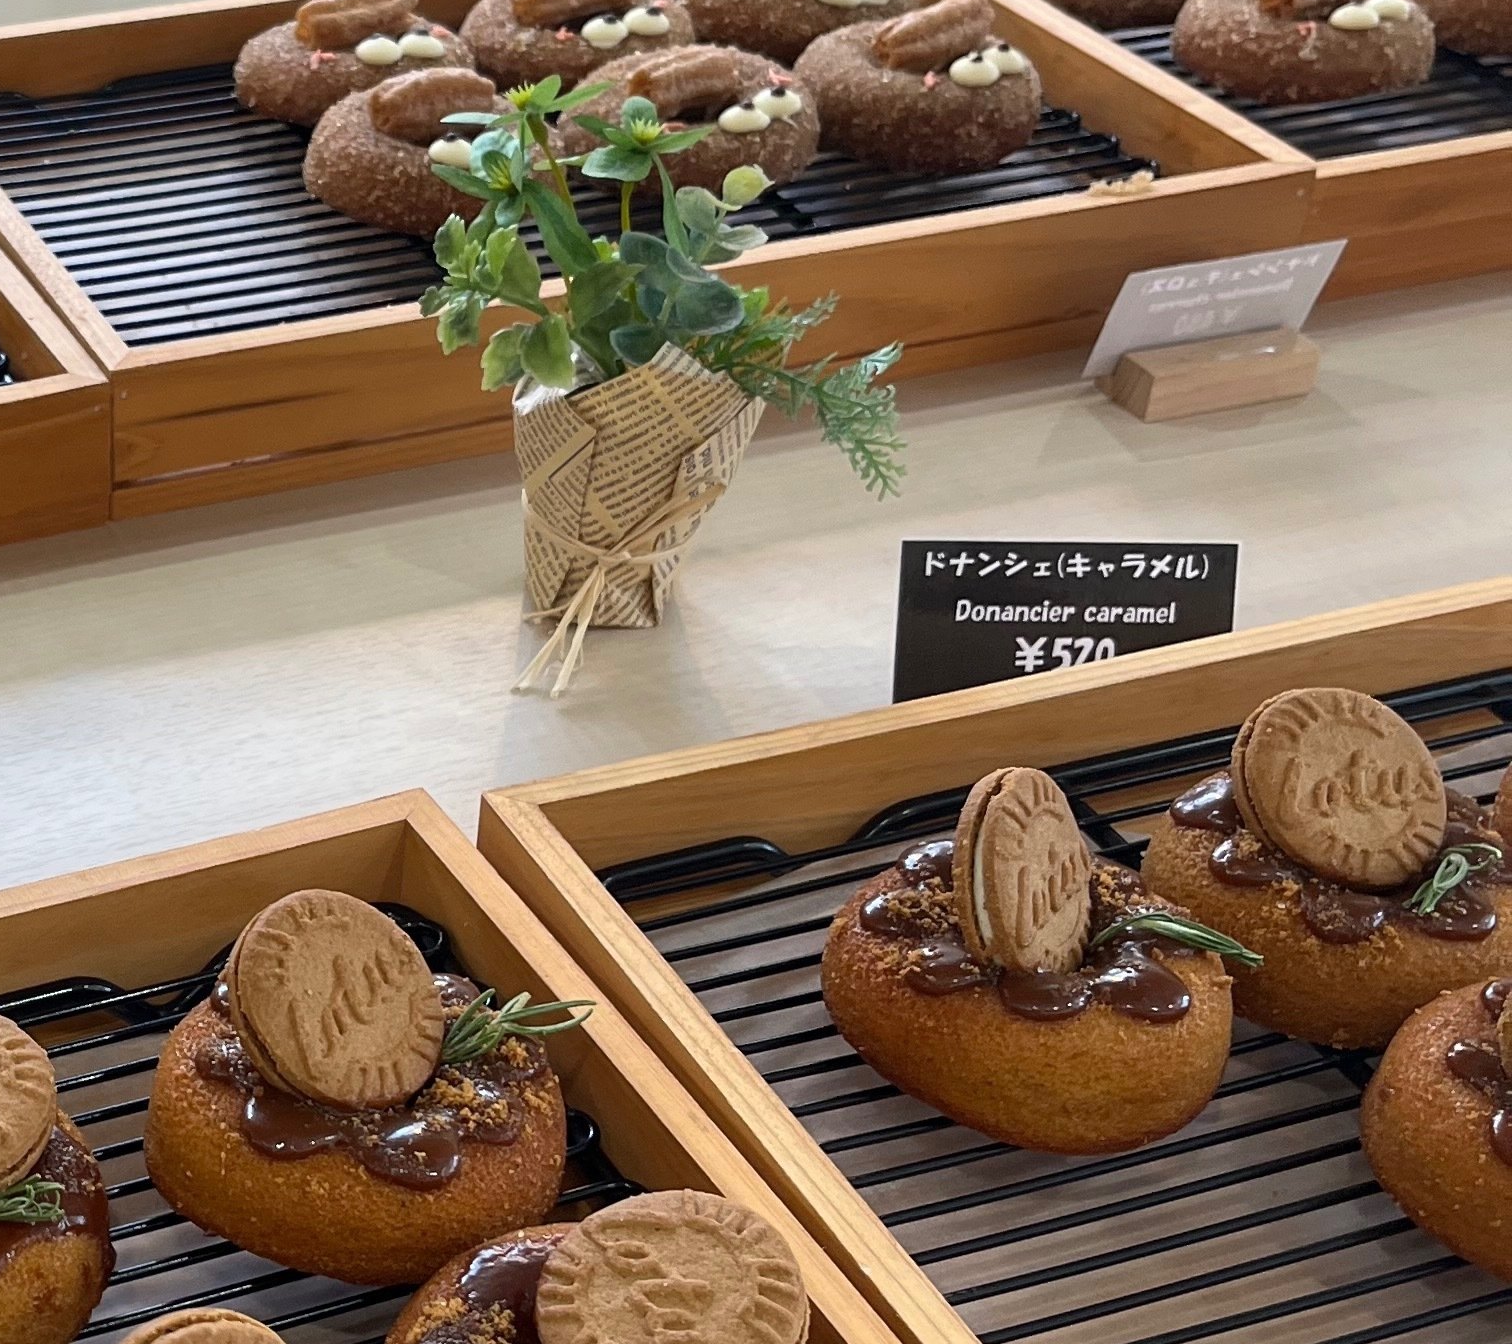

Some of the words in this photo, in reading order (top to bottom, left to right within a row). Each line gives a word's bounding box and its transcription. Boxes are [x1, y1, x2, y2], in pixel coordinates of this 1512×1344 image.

[924, 550, 1210, 581] ドナンシェ(キャラメル)
[954, 599, 1076, 623] Donancier
[1083, 602, 1177, 624] caramel
